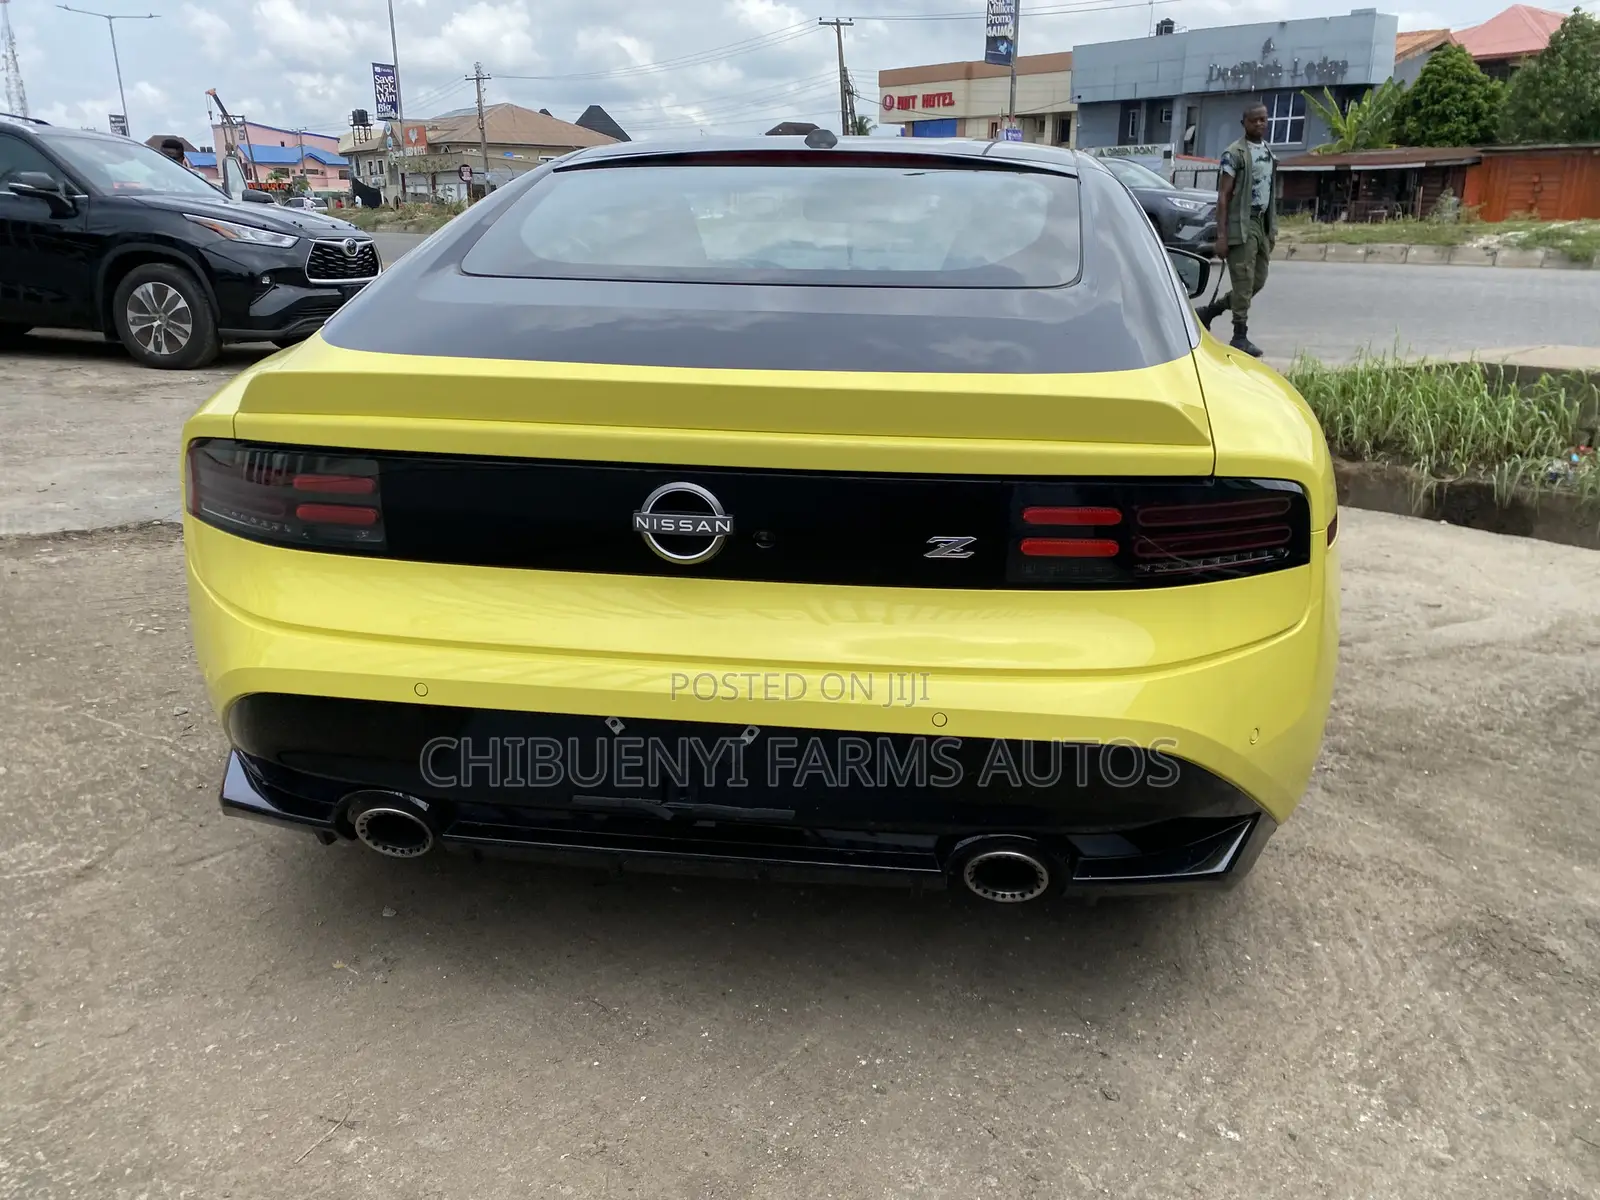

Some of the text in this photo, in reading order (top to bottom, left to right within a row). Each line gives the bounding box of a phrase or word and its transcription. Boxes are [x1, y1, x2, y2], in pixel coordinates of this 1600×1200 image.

[988, 14, 1011, 24] Promo
[375, 74, 394, 84] Save
[377, 93, 395, 102] Win
[922, 92, 955, 108] HOTEL
[378, 103, 391, 112] Big
[1107, 146, 1158, 156] GREEN POINT
[636, 516, 731, 533] NISSAN
[923, 536, 977, 559] Z
